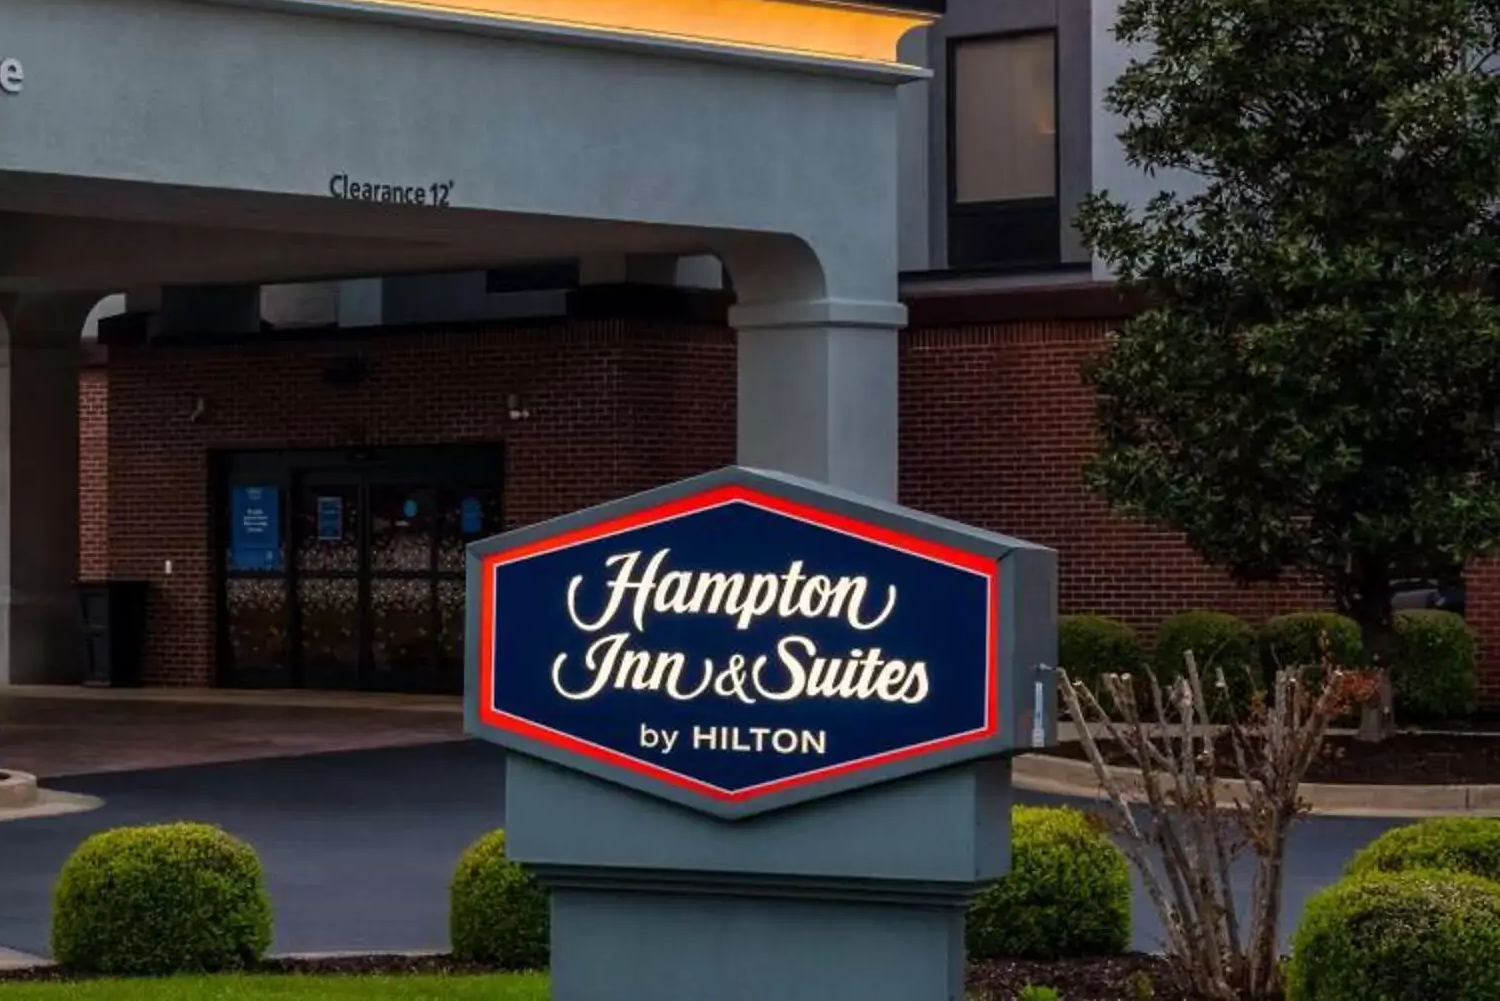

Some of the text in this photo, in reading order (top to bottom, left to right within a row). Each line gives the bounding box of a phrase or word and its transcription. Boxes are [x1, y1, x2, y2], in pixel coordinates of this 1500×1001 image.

[330, 174, 454, 207] Clearance 12'
[567, 548, 896, 632] Hampton
[552, 632, 929, 704] Inn & Suites
[639, 722, 827, 755] by HILTON
